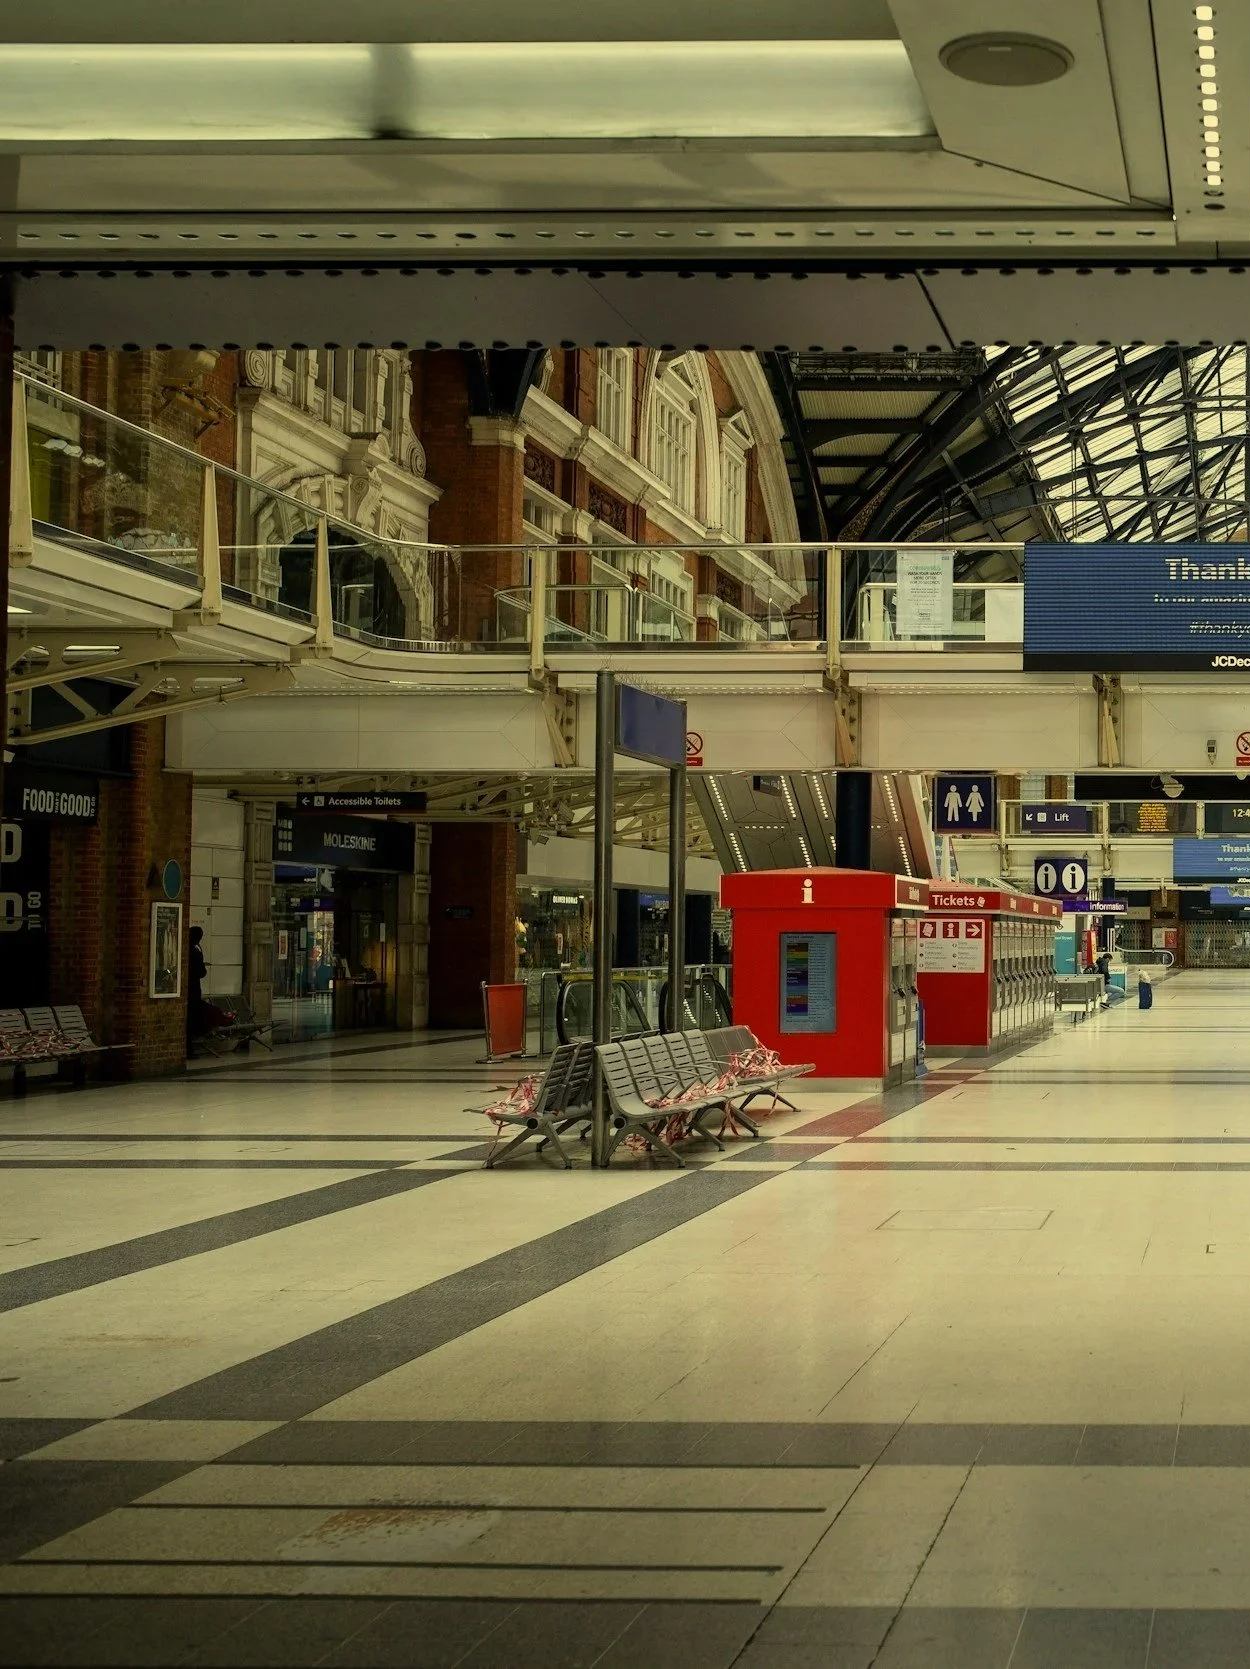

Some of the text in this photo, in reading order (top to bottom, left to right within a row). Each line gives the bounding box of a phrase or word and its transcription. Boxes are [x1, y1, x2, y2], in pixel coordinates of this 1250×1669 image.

[23, 787, 54, 814] FOOD
[59, 792, 91, 818] GOOD
[328, 797, 401, 806] Accessible Toilets
[1054, 813, 1070, 822] Lift
[323, 832, 377, 851] MOLESKINE
[27, 891, 42, 909] GO
[932, 894, 975, 906] Tickets
[1090, 902, 1125, 911] information
